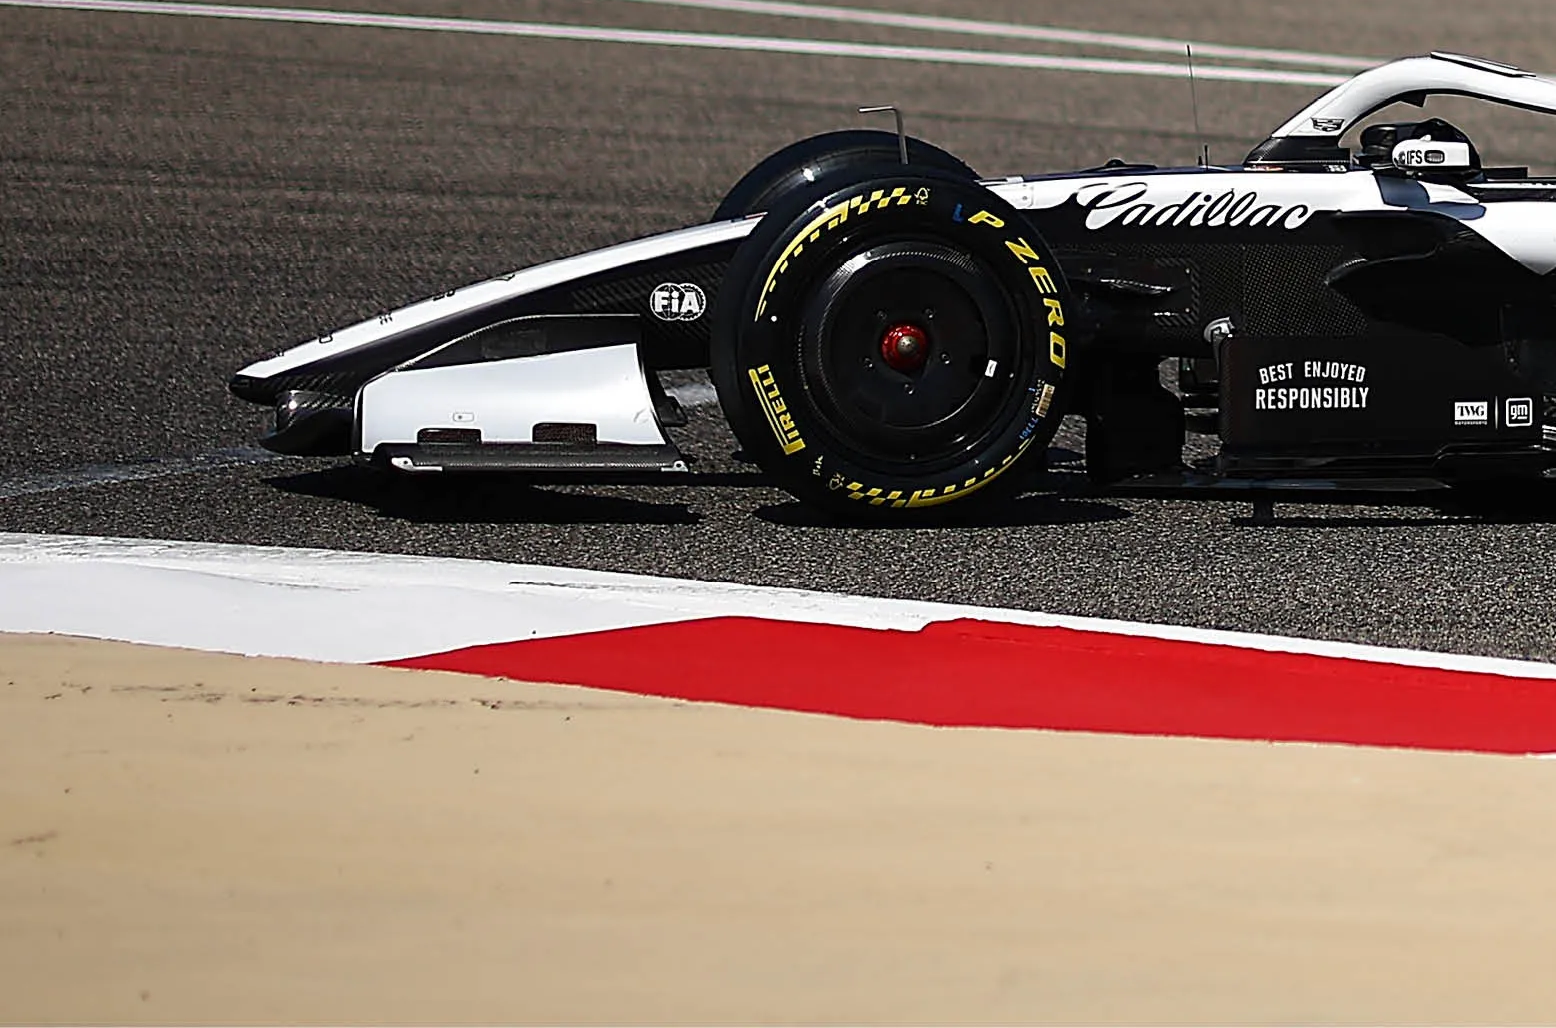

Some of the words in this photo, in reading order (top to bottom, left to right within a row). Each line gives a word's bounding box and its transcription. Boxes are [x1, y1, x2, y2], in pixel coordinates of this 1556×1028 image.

[1406, 149, 1423, 165] IFS
[1077, 182, 1310, 229] Cadillac
[967, 210, 1005, 228] P
[1004, 237, 1066, 370] ZERO
[1259, 363, 1294, 385] BEST
[1304, 361, 1366, 383] ENJOYED
[748, 363, 807, 456] PIRELLI
[1255, 387, 1369, 410] RESPONSIBLY
[1456, 405, 1486, 417] TWG
[1510, 404, 1529, 421] gm
